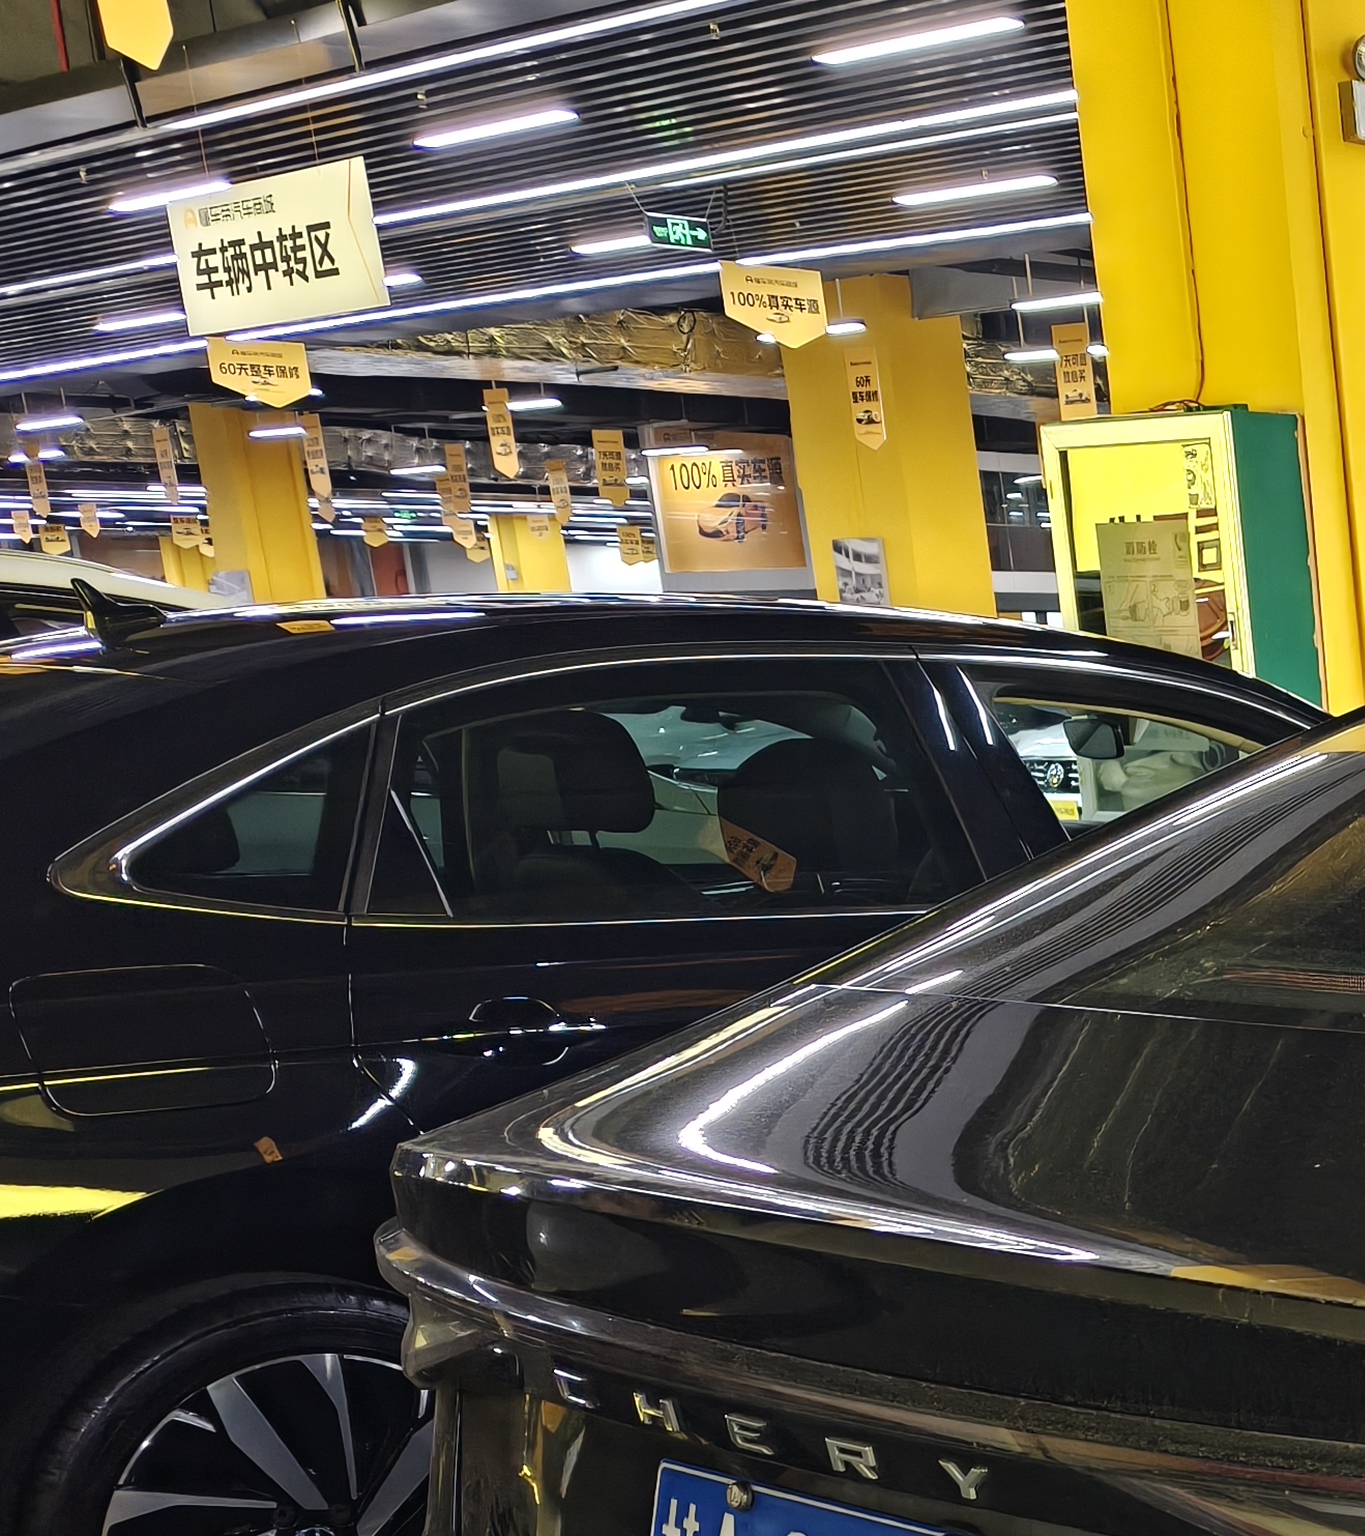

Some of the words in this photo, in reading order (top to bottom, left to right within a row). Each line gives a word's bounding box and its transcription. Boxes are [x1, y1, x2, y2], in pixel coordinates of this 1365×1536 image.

[191, 221, 340, 300] 车辆中转区
[730, 291, 821, 314] 100%真实车源
[218, 361, 301, 380] 60天整车保修
[669, 461, 718, 491] 100%
[719, 457, 785, 488] 真实车源
[553, 1367, 989, 1501] CHERY
